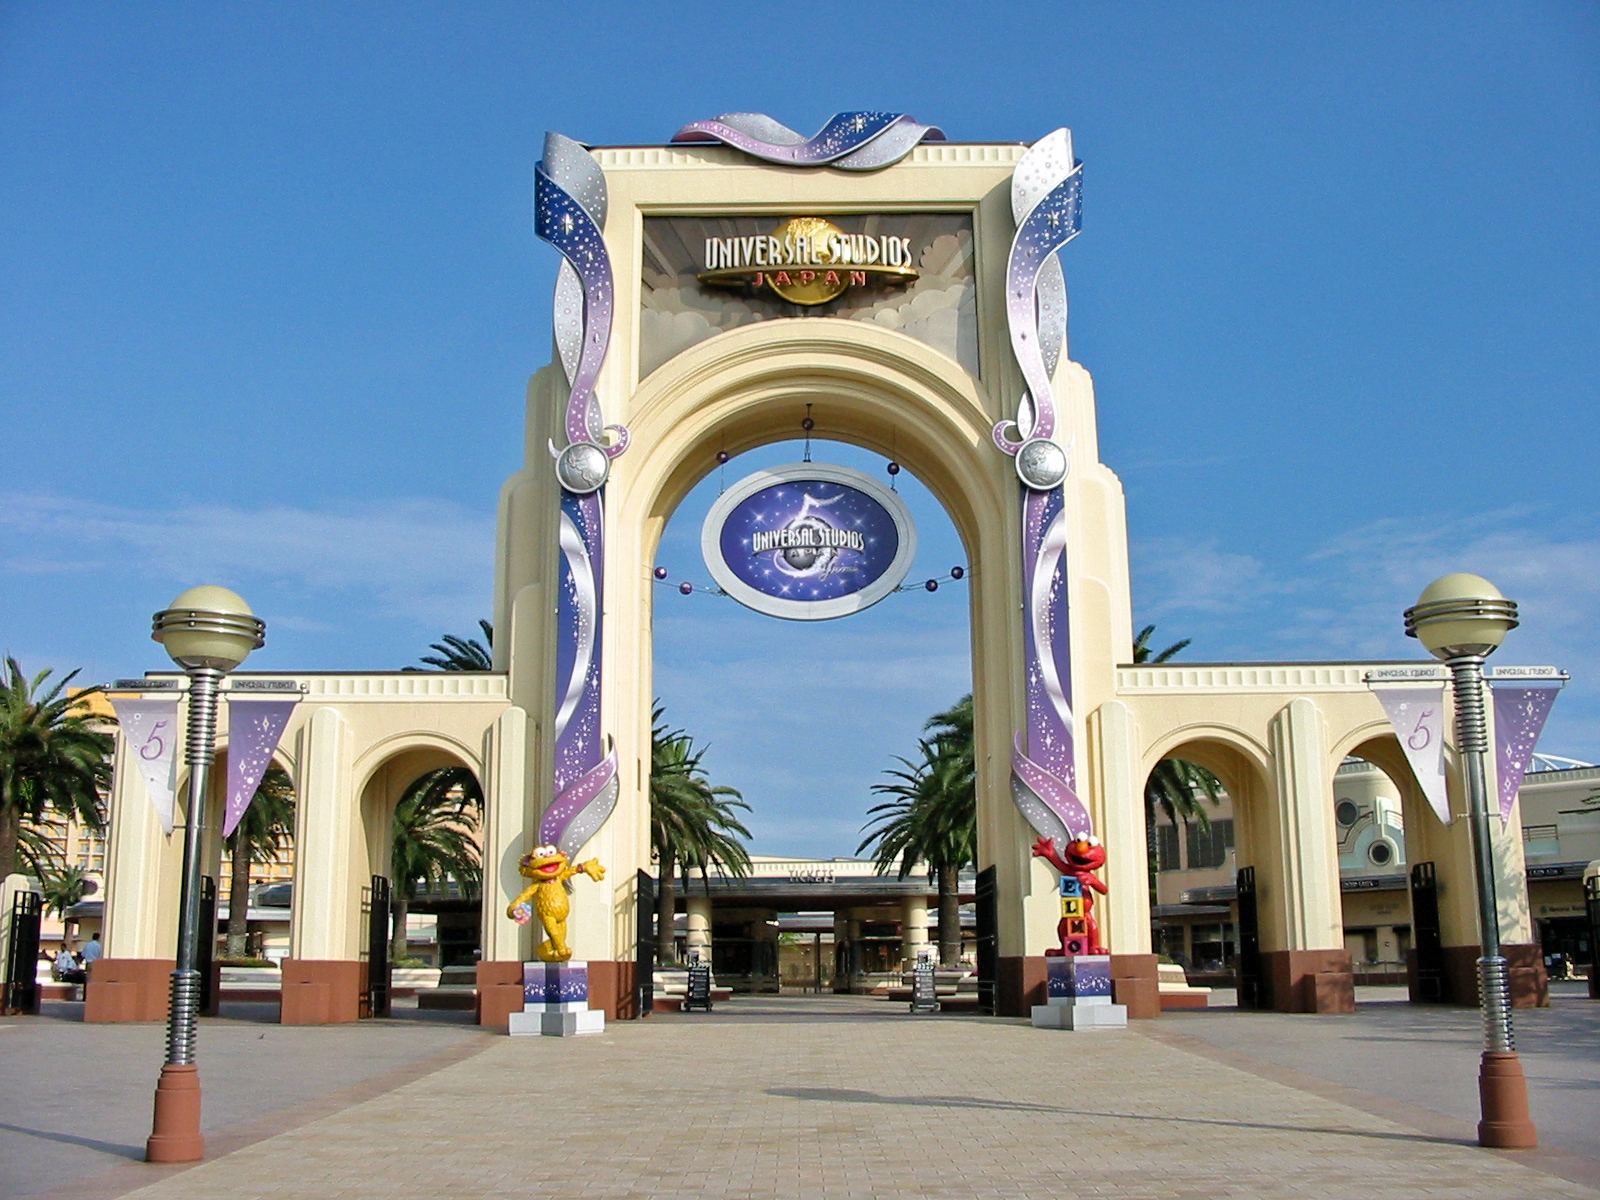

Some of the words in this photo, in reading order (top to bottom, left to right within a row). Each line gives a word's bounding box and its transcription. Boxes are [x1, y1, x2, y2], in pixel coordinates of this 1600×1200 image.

[705, 235, 822, 269] UNIVERSAL
[826, 232, 912, 267] STUDIOS
[752, 270, 866, 287] JAPAN
[752, 528, 816, 552] UNIVERSAL
[818, 528, 865, 551] STUDIOS
[140, 719, 168, 761] 5
[1408, 710, 1434, 751] 5
[788, 869, 835, 885] TICKETS
